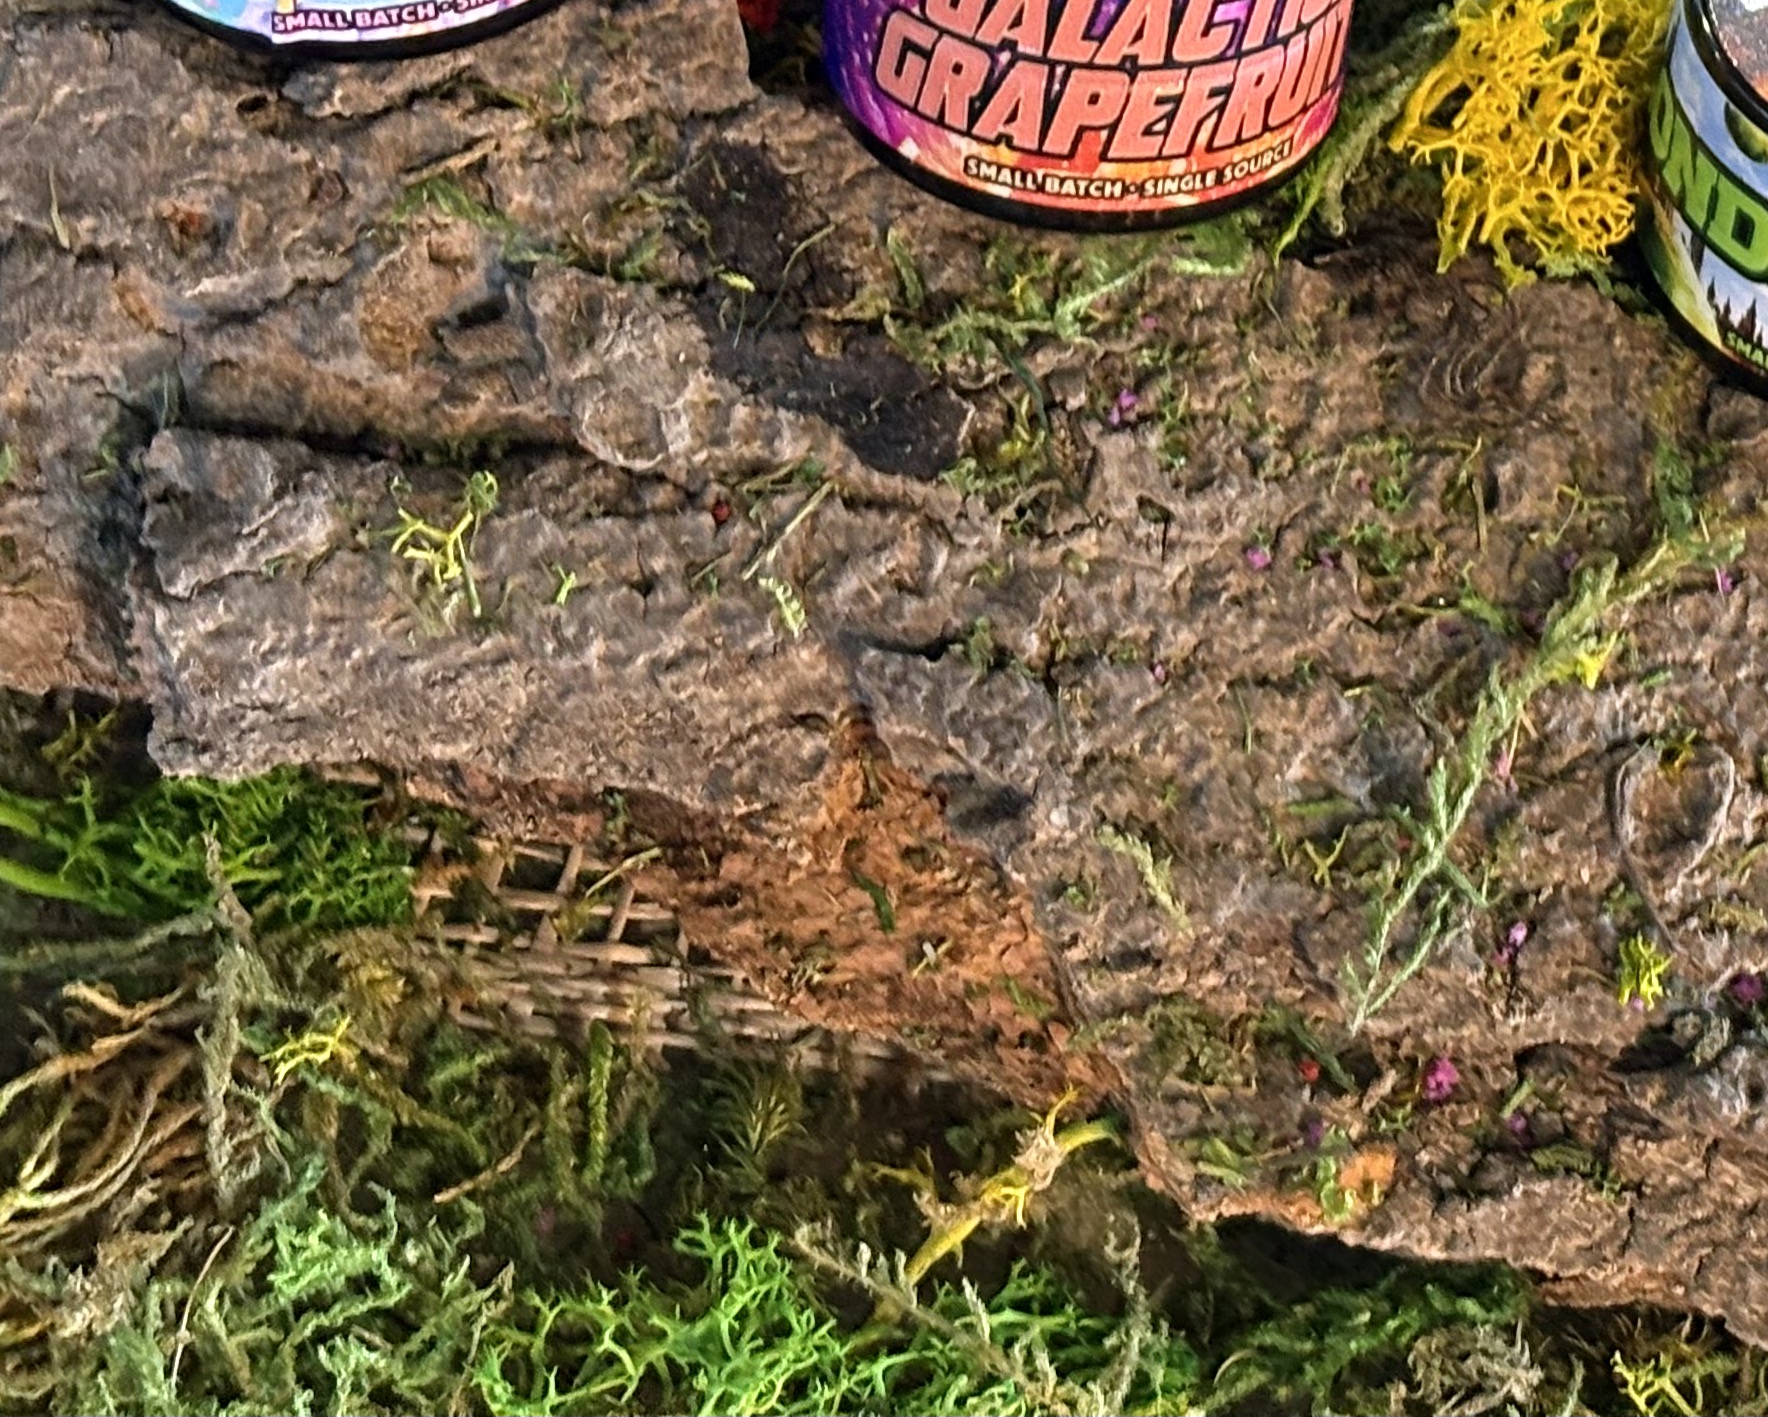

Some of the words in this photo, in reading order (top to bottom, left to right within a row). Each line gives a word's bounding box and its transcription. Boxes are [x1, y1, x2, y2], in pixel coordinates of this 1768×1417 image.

[272, 8, 350, 32] SMALL
[355, 0, 438, 30] BATCH
[965, 157, 1038, 189] SMALL
[1045, 176, 1123, 199] BATCH
[1142, 170, 1217, 197] SINGLE
[1222, 140, 1293, 182] SOURCE
